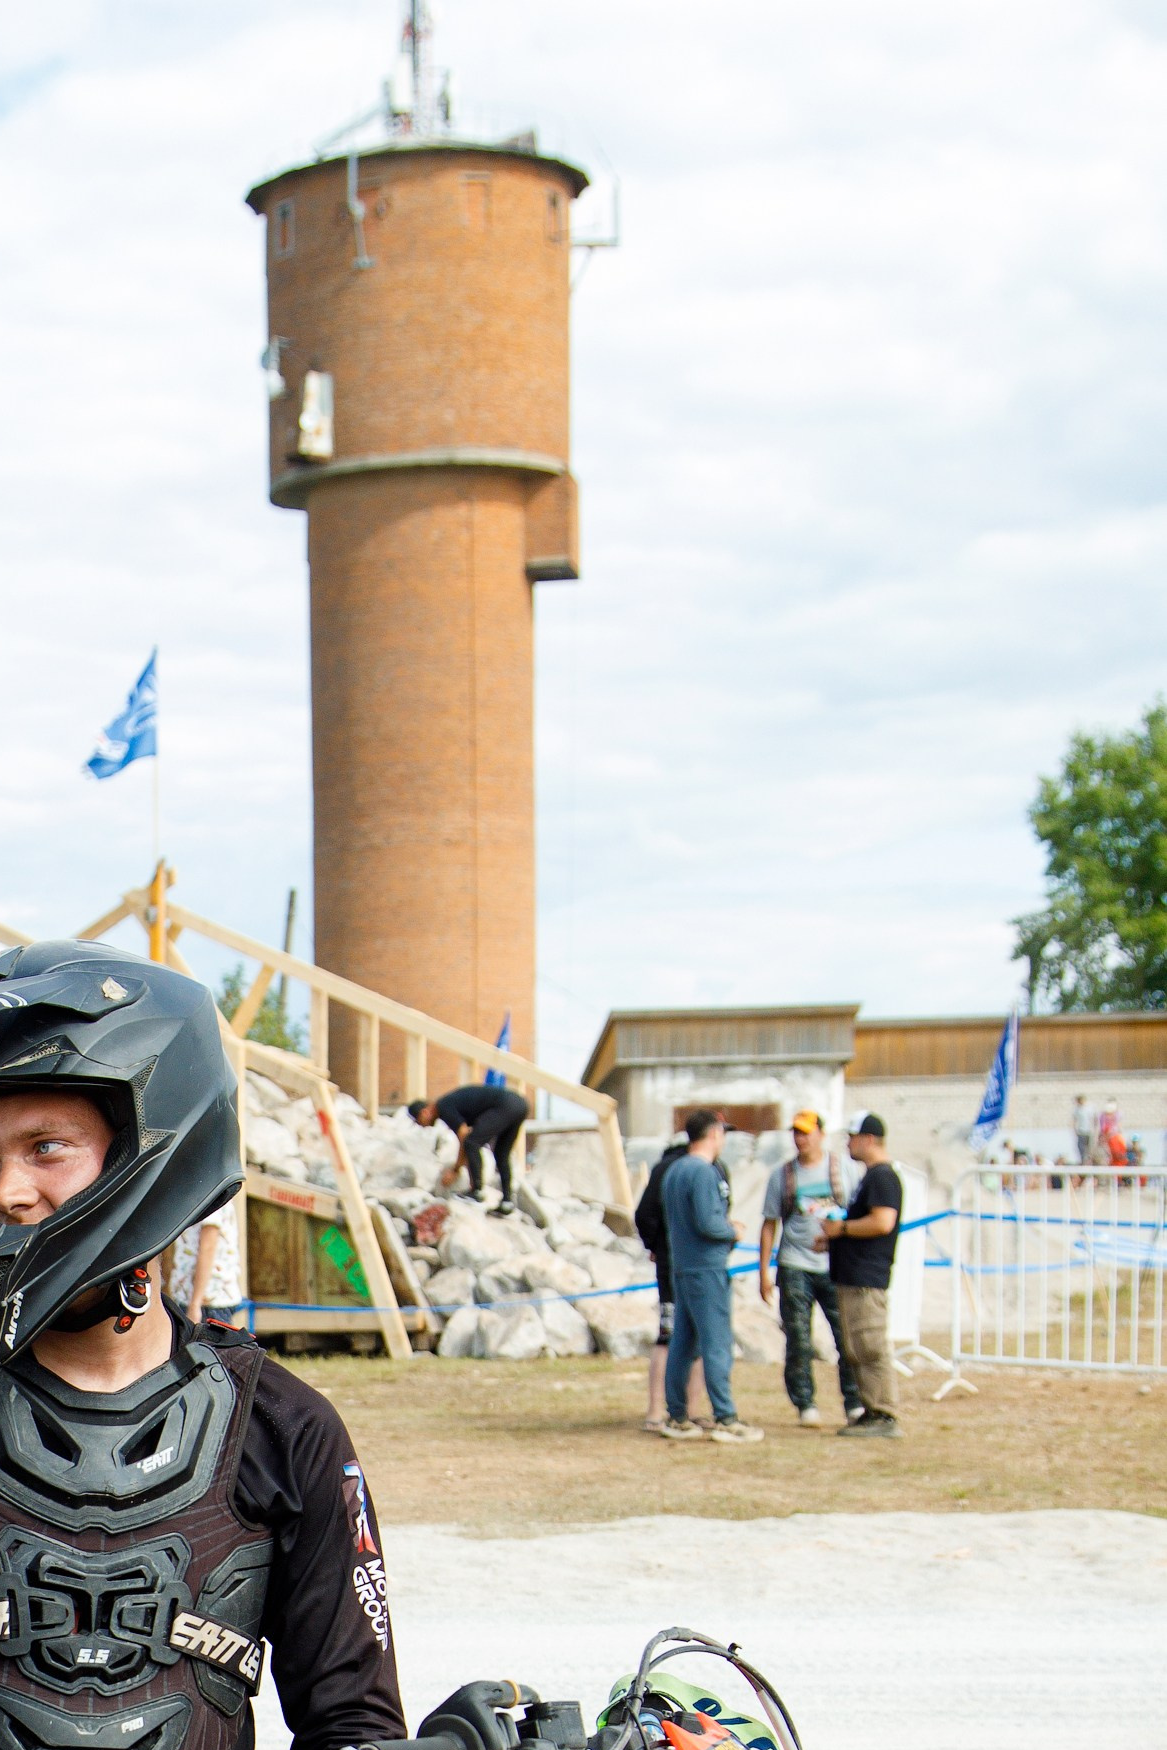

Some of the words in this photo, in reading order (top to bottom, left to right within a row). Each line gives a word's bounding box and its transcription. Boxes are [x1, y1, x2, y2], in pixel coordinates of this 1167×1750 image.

[4, 1291, 24, 1350] Airoh
[169, 1612, 250, 1664] EATT
[76, 1648, 111, 1664] 5.5
[121, 1716, 144, 1734] PRO
